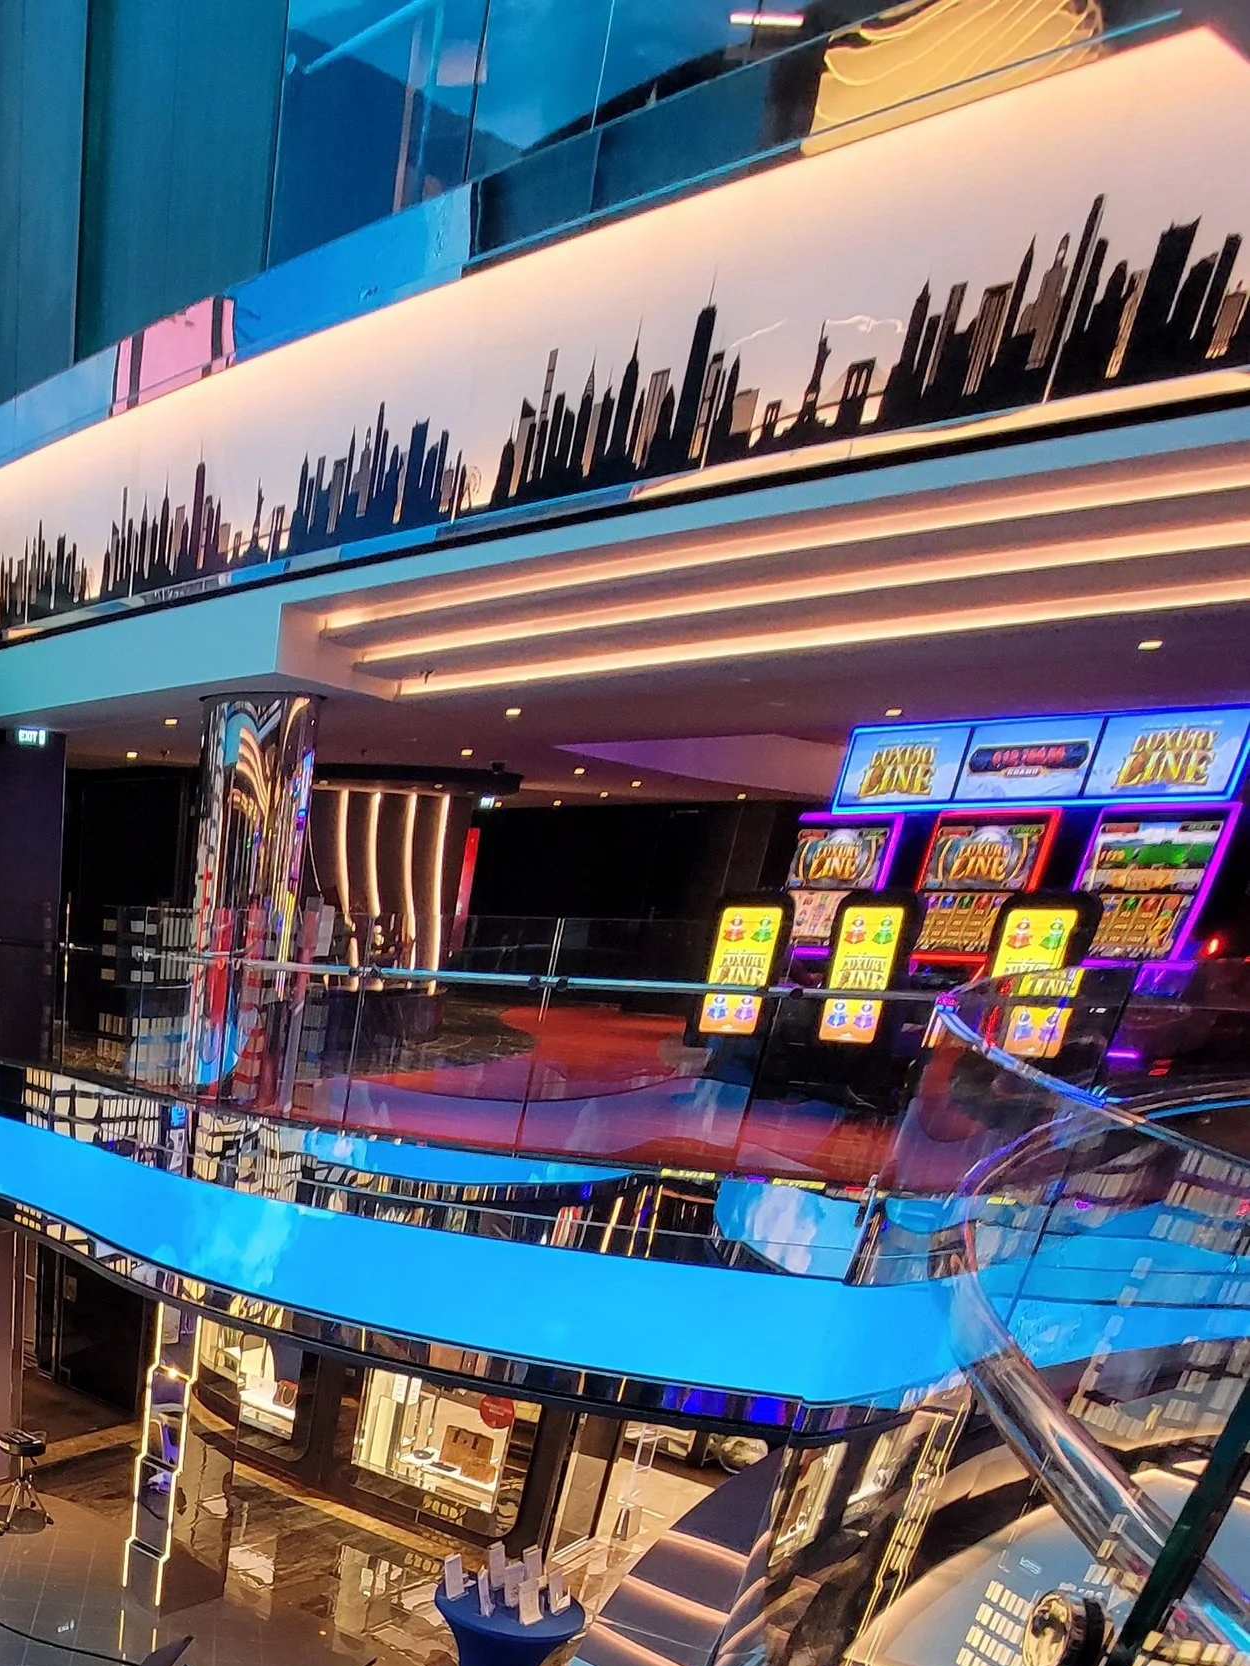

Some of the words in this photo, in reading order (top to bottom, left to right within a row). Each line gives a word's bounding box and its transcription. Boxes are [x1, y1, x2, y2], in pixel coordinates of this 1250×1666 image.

[18, 730, 39, 743] EXIT
[1130, 728, 1222, 754] LUXURY
[870, 744, 938, 769] LUXURY
[1111, 749, 1216, 788] LINE
[858, 763, 937, 797] LINE
[808, 856, 858, 880] LINE
[949, 856, 1007, 881] LINE
